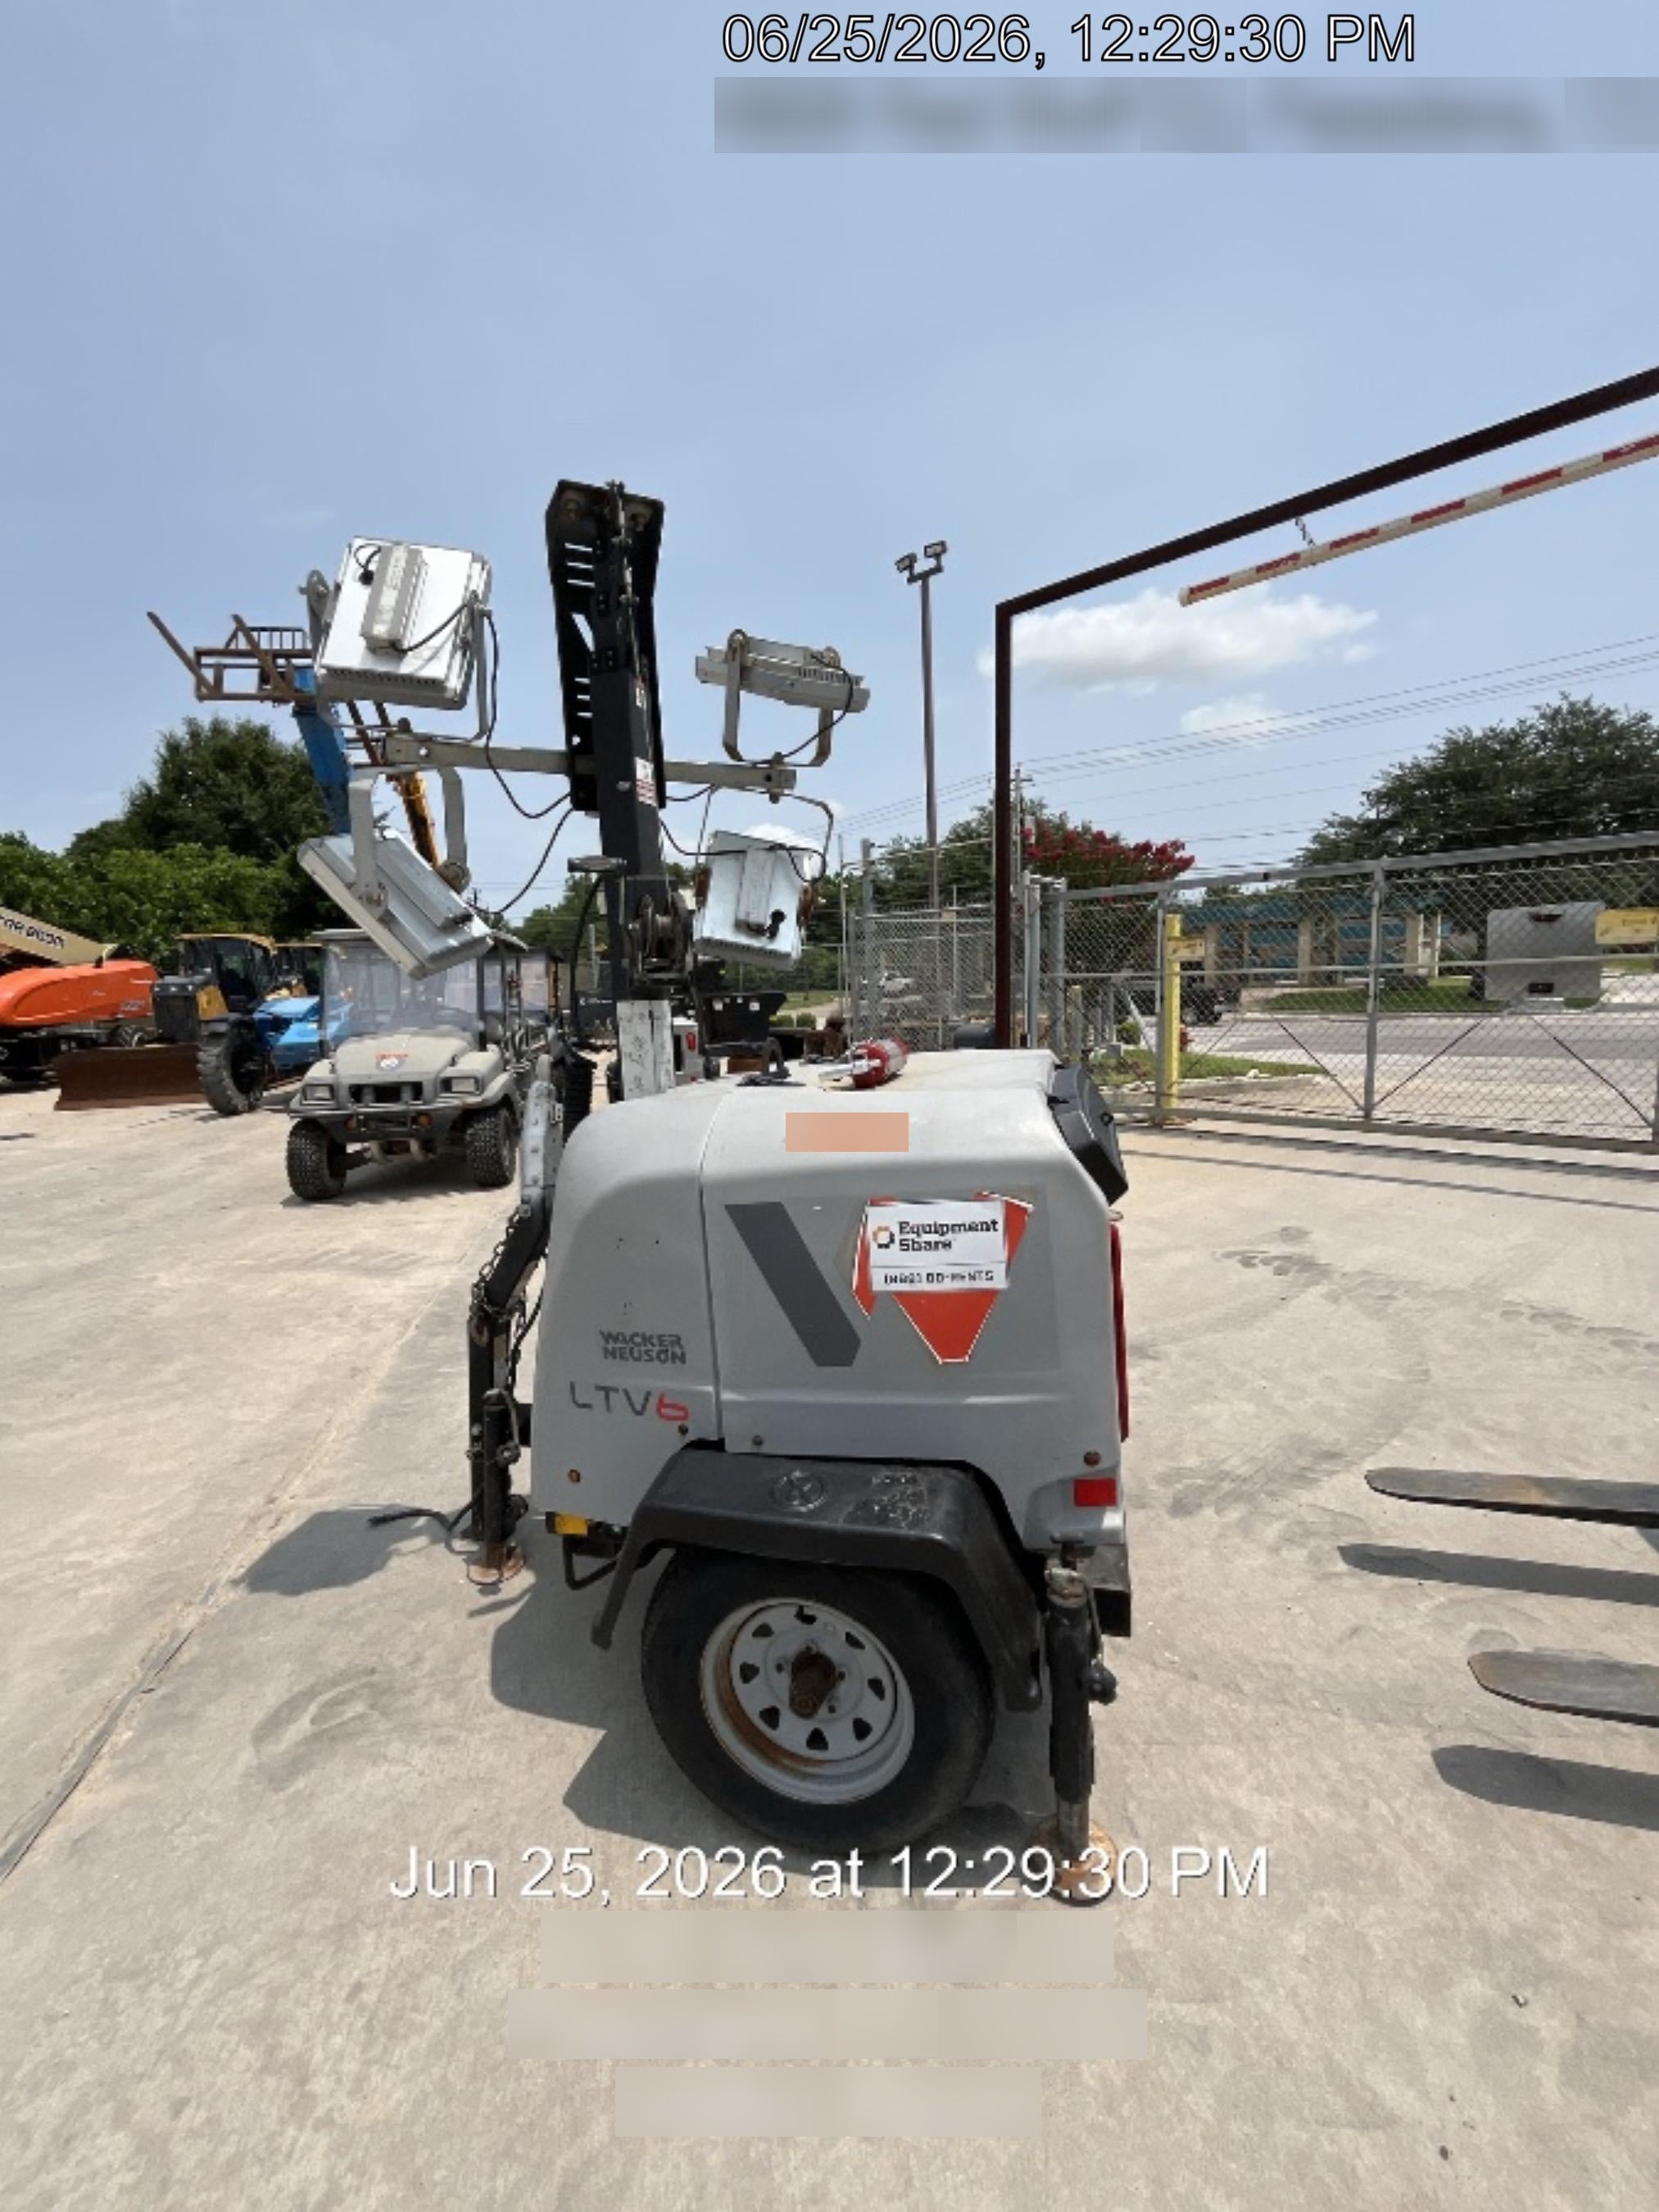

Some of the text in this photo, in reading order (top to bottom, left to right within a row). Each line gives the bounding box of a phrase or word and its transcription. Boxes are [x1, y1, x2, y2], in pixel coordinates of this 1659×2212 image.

[899, 1219, 999, 1238] Equipment
[899, 1239, 953, 1253] Share
[600, 1330, 684, 1349] WACKER
[603, 1347, 687, 1365] NEUSON
[569, 1380, 689, 1421] LTV6
